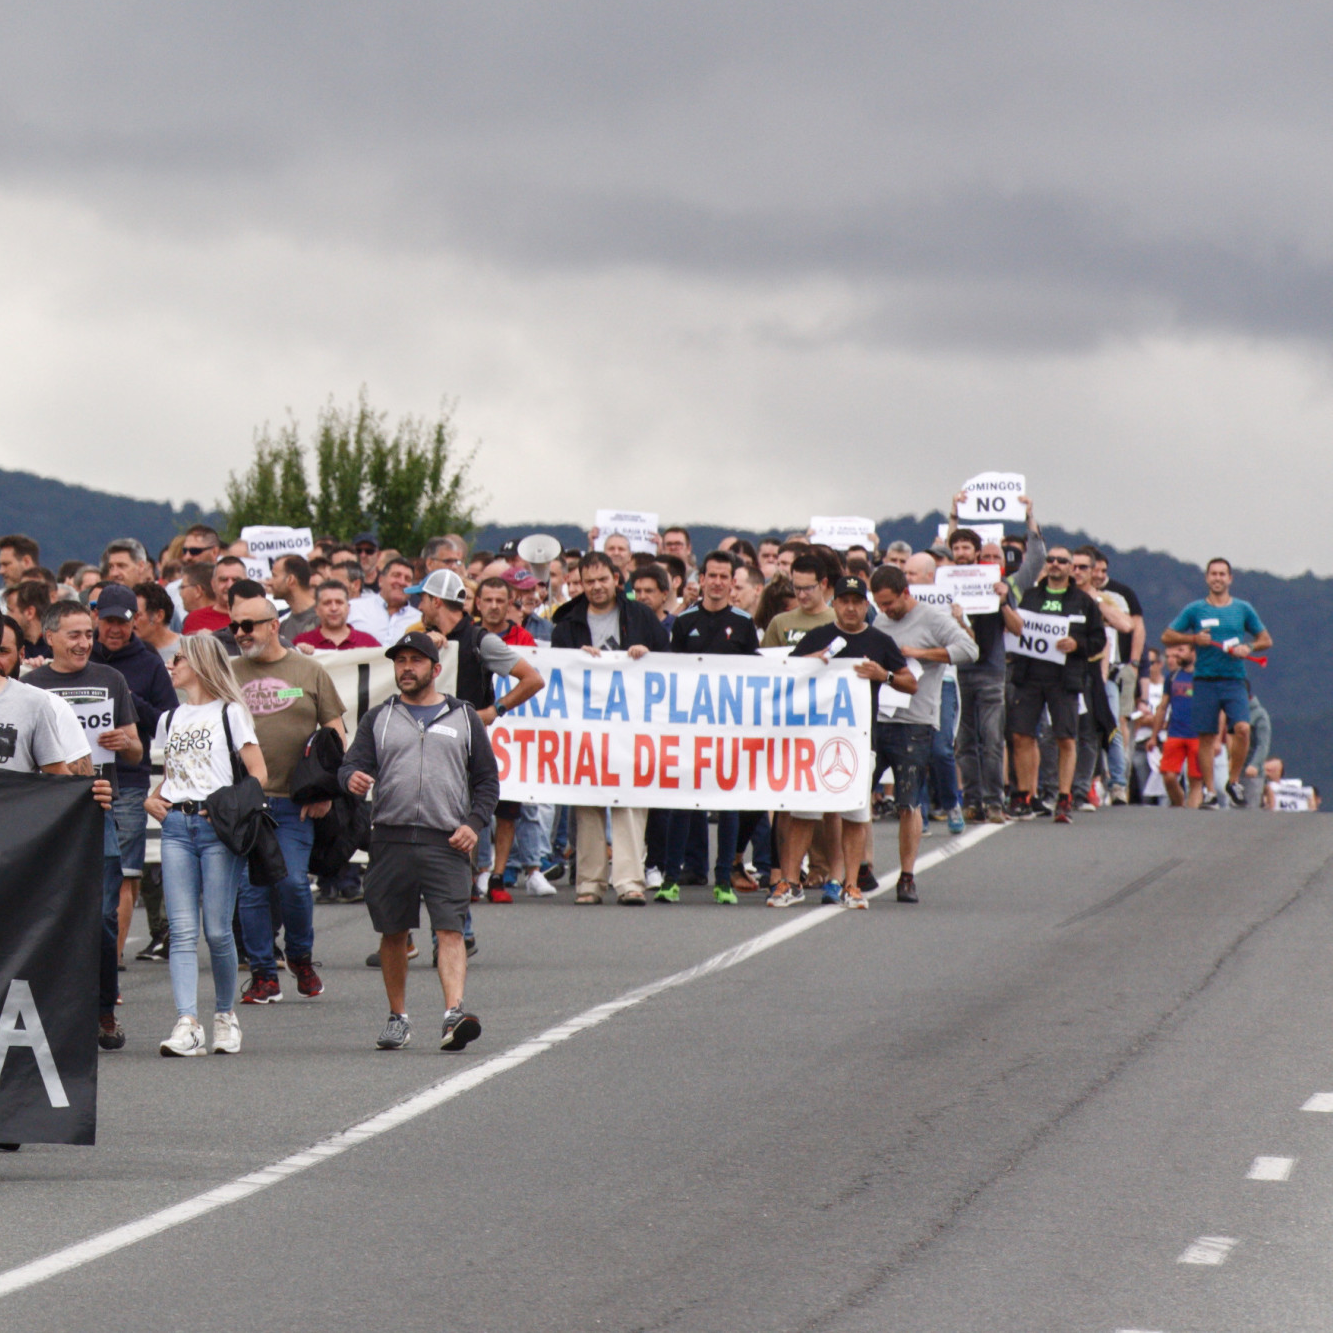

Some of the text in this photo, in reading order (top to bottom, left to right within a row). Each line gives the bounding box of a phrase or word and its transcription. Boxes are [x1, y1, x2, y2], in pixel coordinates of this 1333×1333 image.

[965, 481, 1022, 492] OMINGOS
[976, 496, 1006, 513] NO
[250, 537, 311, 552] DOMINGOS
[1019, 634, 1049, 654] NO
[582, 668, 630, 722] LA
[643, 670, 857, 728] PLANTILLA
[170, 728, 211, 742] GOOD
[164, 740, 213, 755] ENERGY
[492, 726, 620, 788] STRIAL
[633, 733, 680, 790] DE
